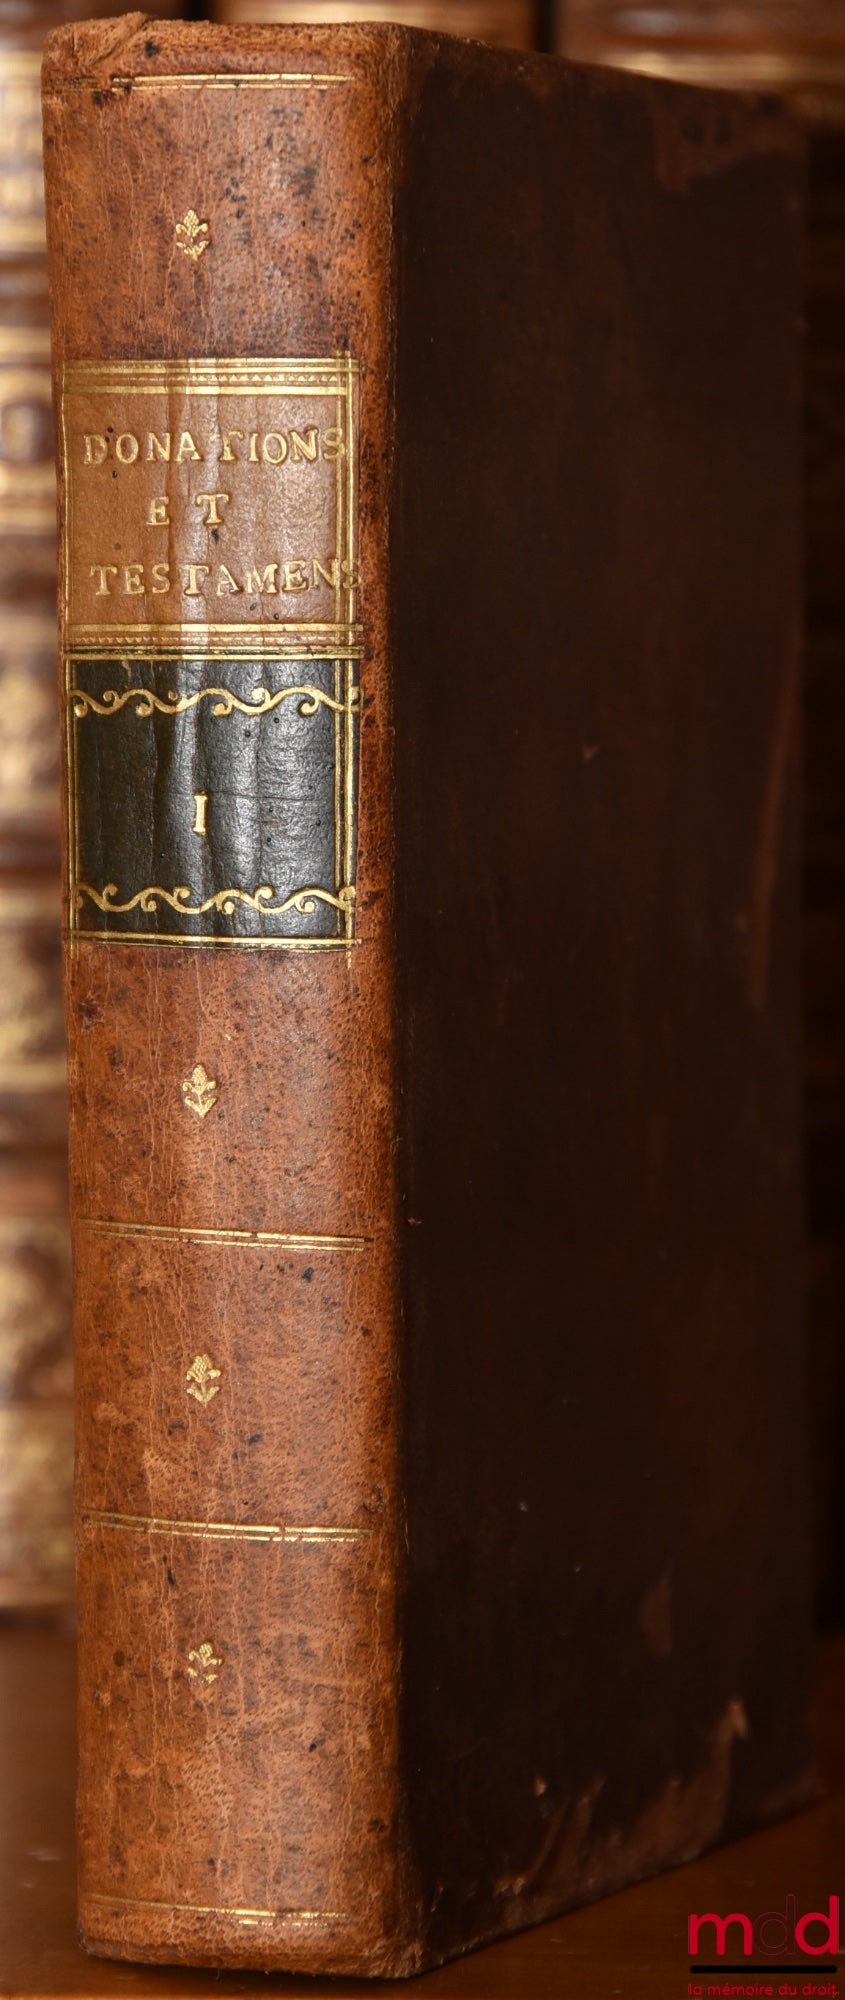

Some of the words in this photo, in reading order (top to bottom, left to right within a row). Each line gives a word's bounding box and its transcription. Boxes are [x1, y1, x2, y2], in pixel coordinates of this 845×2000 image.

[84, 427, 346, 464] DONATIONS
[147, 493, 229, 526] ET
[89, 558, 362, 597] TESTAMENS
[193, 791, 207, 835] I
